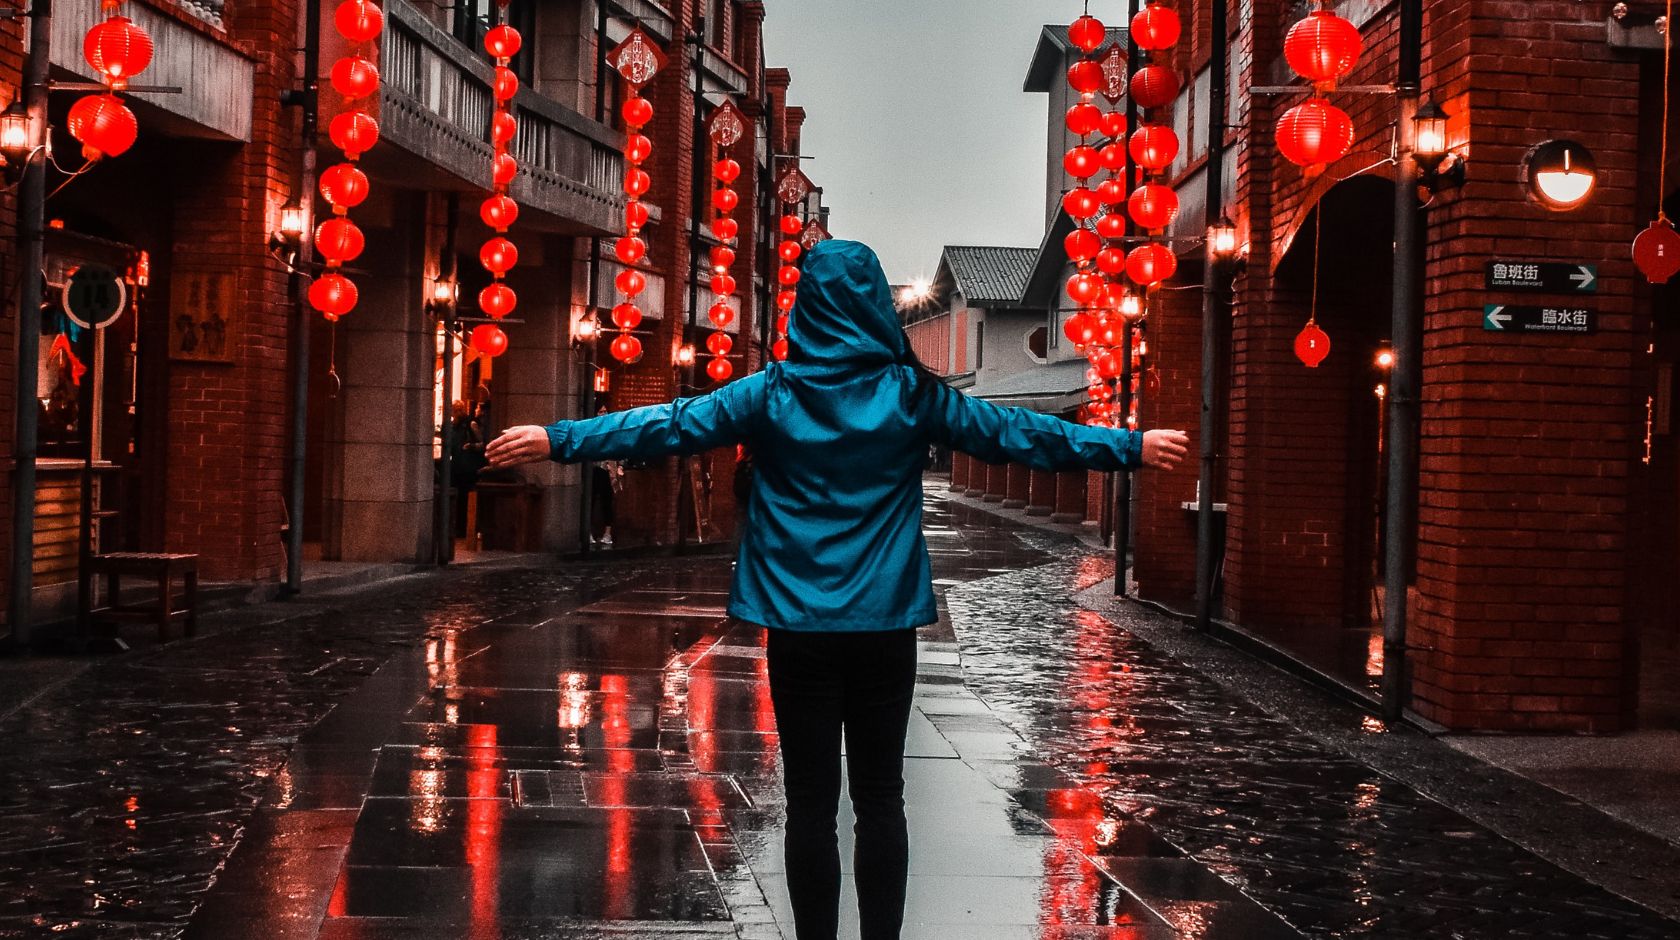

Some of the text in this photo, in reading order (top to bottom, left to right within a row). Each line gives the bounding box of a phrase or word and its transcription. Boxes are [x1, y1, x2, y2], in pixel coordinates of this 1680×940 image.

[1493, 263, 1538, 280] 魯班街
[1542, 309, 1588, 325] 臨水街
